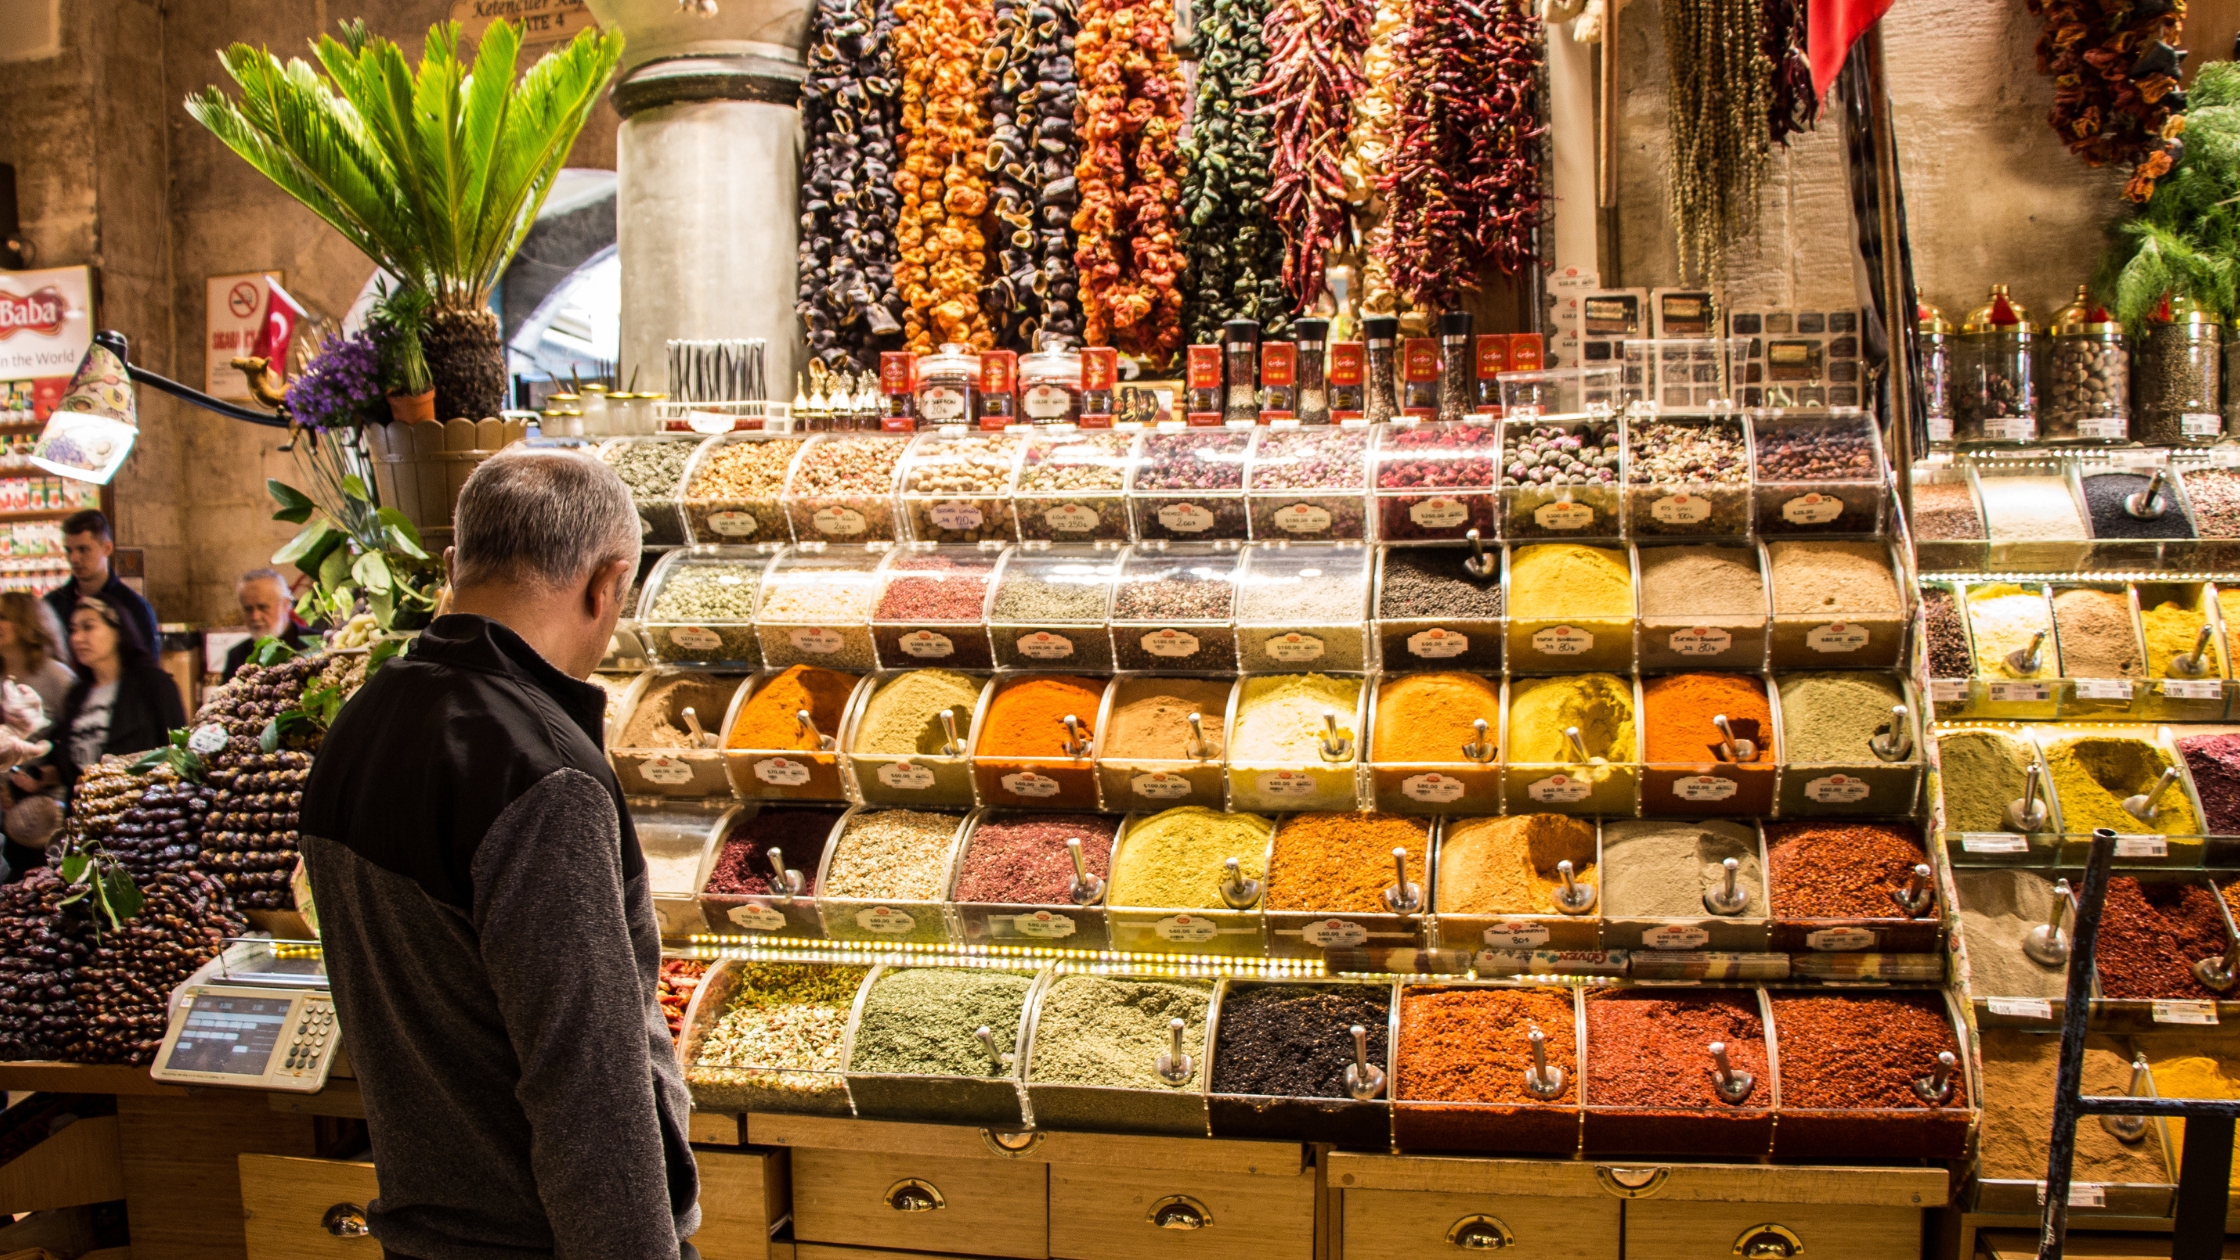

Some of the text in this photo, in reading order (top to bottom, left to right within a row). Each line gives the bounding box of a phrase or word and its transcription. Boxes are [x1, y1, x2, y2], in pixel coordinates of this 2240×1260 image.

[555, 13, 565, 27] 4
[0, 297, 57, 327] Baba
[12, 353, 32, 367] the
[36, 349, 74, 365] World
[1557, 952, 1607, 965] GÜVEN
